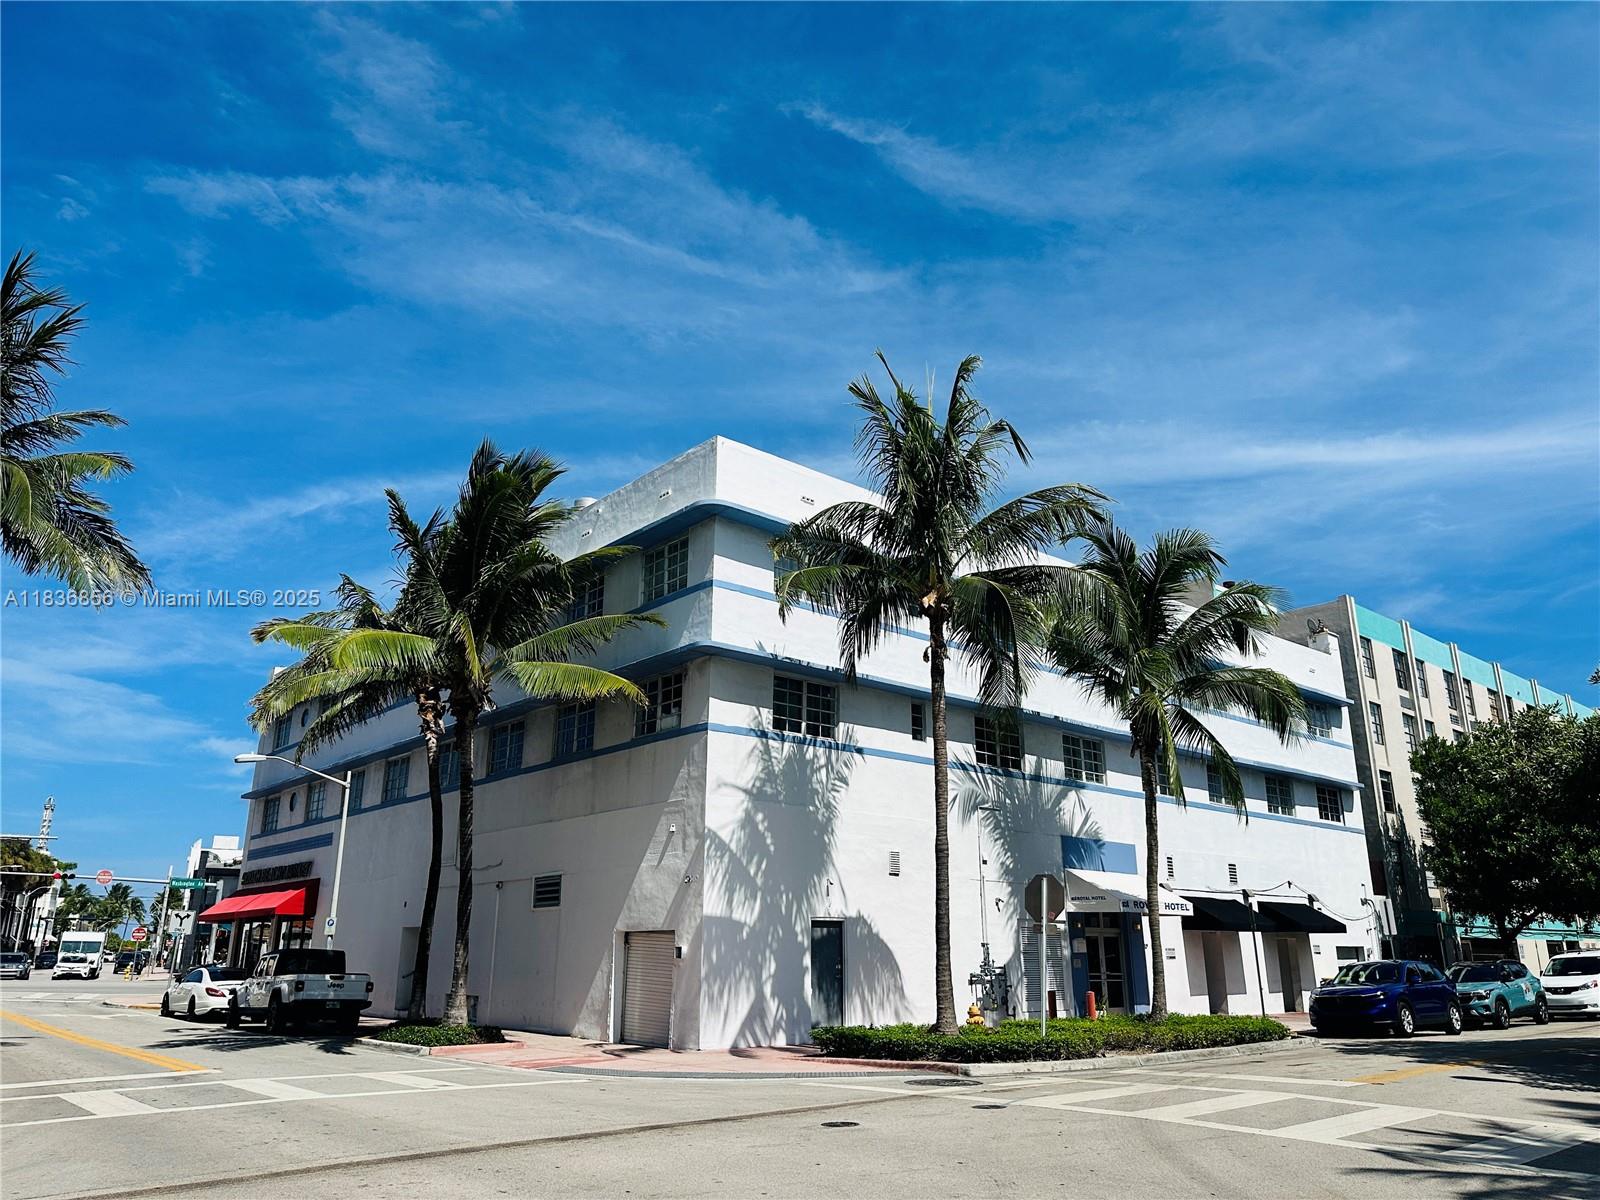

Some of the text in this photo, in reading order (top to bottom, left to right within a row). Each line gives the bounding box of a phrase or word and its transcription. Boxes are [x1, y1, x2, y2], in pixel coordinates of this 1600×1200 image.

[172, 880, 195, 888] Washington
[1164, 902, 1190, 911] HOTEL
[327, 981, 345, 990] Jeep
